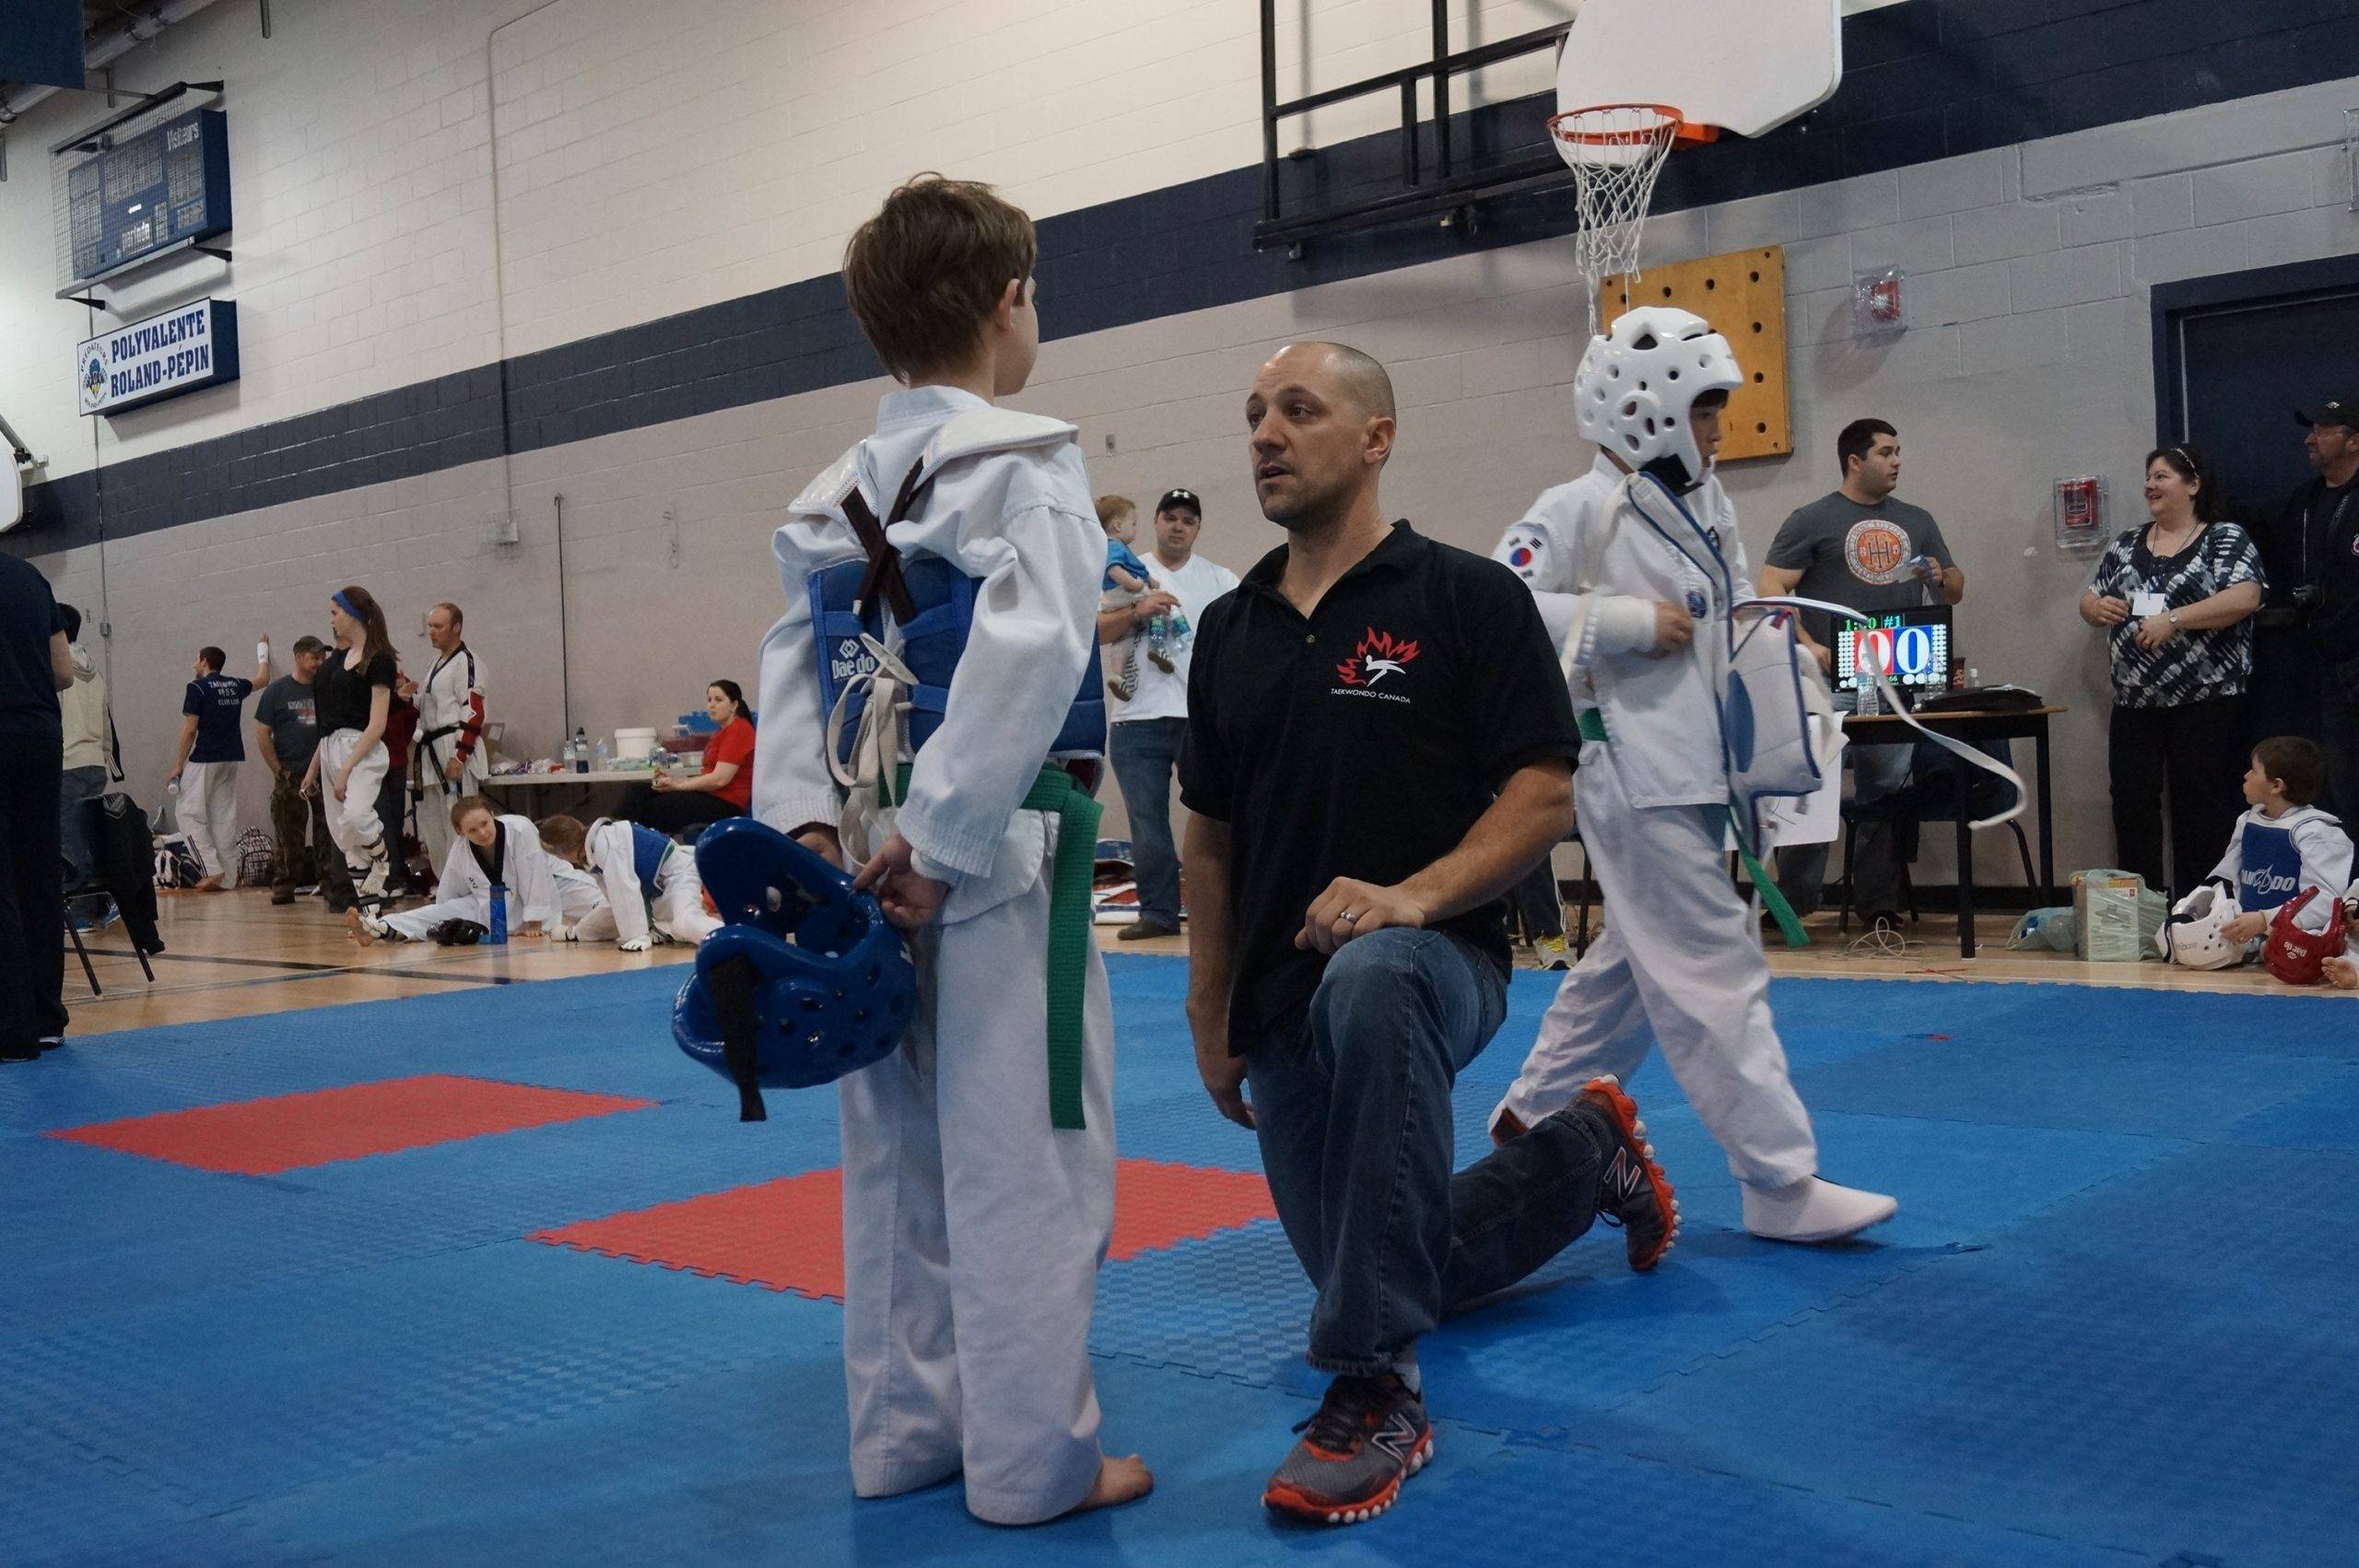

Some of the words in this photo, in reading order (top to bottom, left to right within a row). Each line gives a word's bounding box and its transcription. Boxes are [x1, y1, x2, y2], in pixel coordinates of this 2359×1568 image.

[111, 309, 205, 364] POLYVALENTE
[110, 344, 210, 398] ROLAND-PÉPIN
[1884, 614, 1902, 627] #1
[1895, 628, 1931, 674] 0
[1331, 687, 1377, 698] TAEKWONDO
[1378, 692, 1411, 704] CANADA
